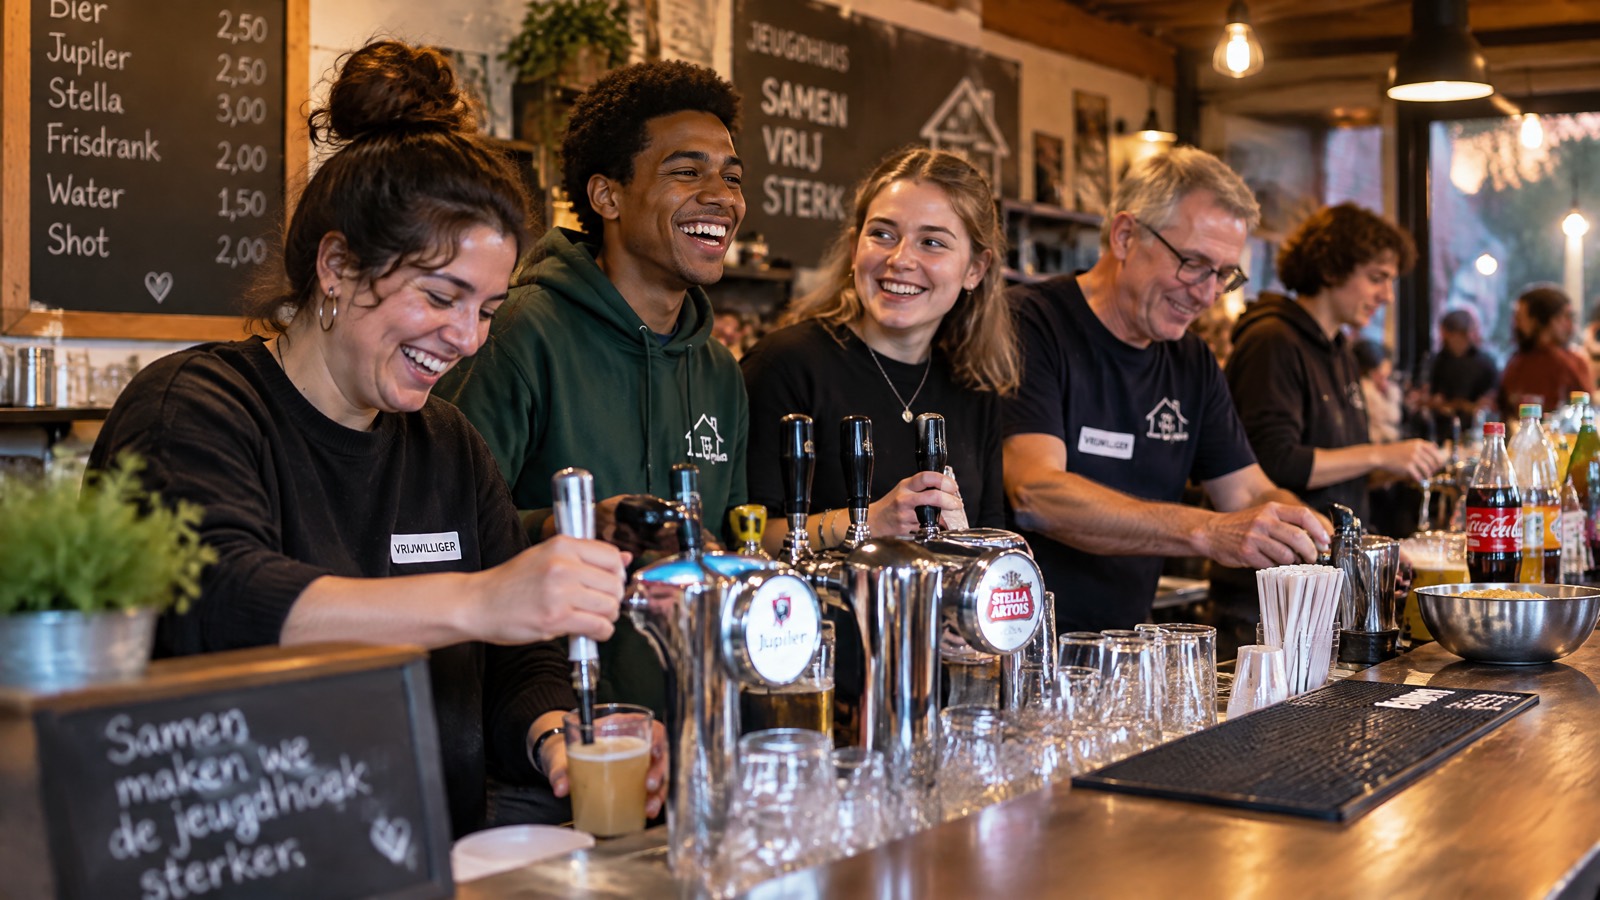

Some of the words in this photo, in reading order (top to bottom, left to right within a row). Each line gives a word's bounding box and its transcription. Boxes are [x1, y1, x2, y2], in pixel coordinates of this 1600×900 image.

[217, 9, 268, 44] 2,50
[746, 21, 849, 74] JEUGDHUIS
[47, 32, 131, 75] Jupiler
[216, 53, 267, 88] 2,50
[49, 77, 124, 114] Stella
[216, 93, 267, 128] 3,00
[761, 77, 848, 128] SAMEN
[47, 122, 161, 162] Frisdrank
[216, 141, 267, 176] 2,00
[762, 125, 823, 173] VRIJ
[47, 173, 125, 209] Water
[218, 187, 266, 222] 1,50
[763, 174, 845, 220] STERK
[48, 222, 110, 258] Shot
[216, 235, 267, 268] 2,00
[394, 540, 457, 555] VRIJWILLIGER
[991, 591, 1029, 605] STELLA
[991, 603, 1029, 618] ARTOIS
[759, 630, 807, 651] Jupiler
[105, 708, 249, 764] Samen
[115, 751, 250, 808] maken
[259, 736, 314, 774] we
[109, 810, 162, 860] de
[140, 837, 306, 900] sterker.
